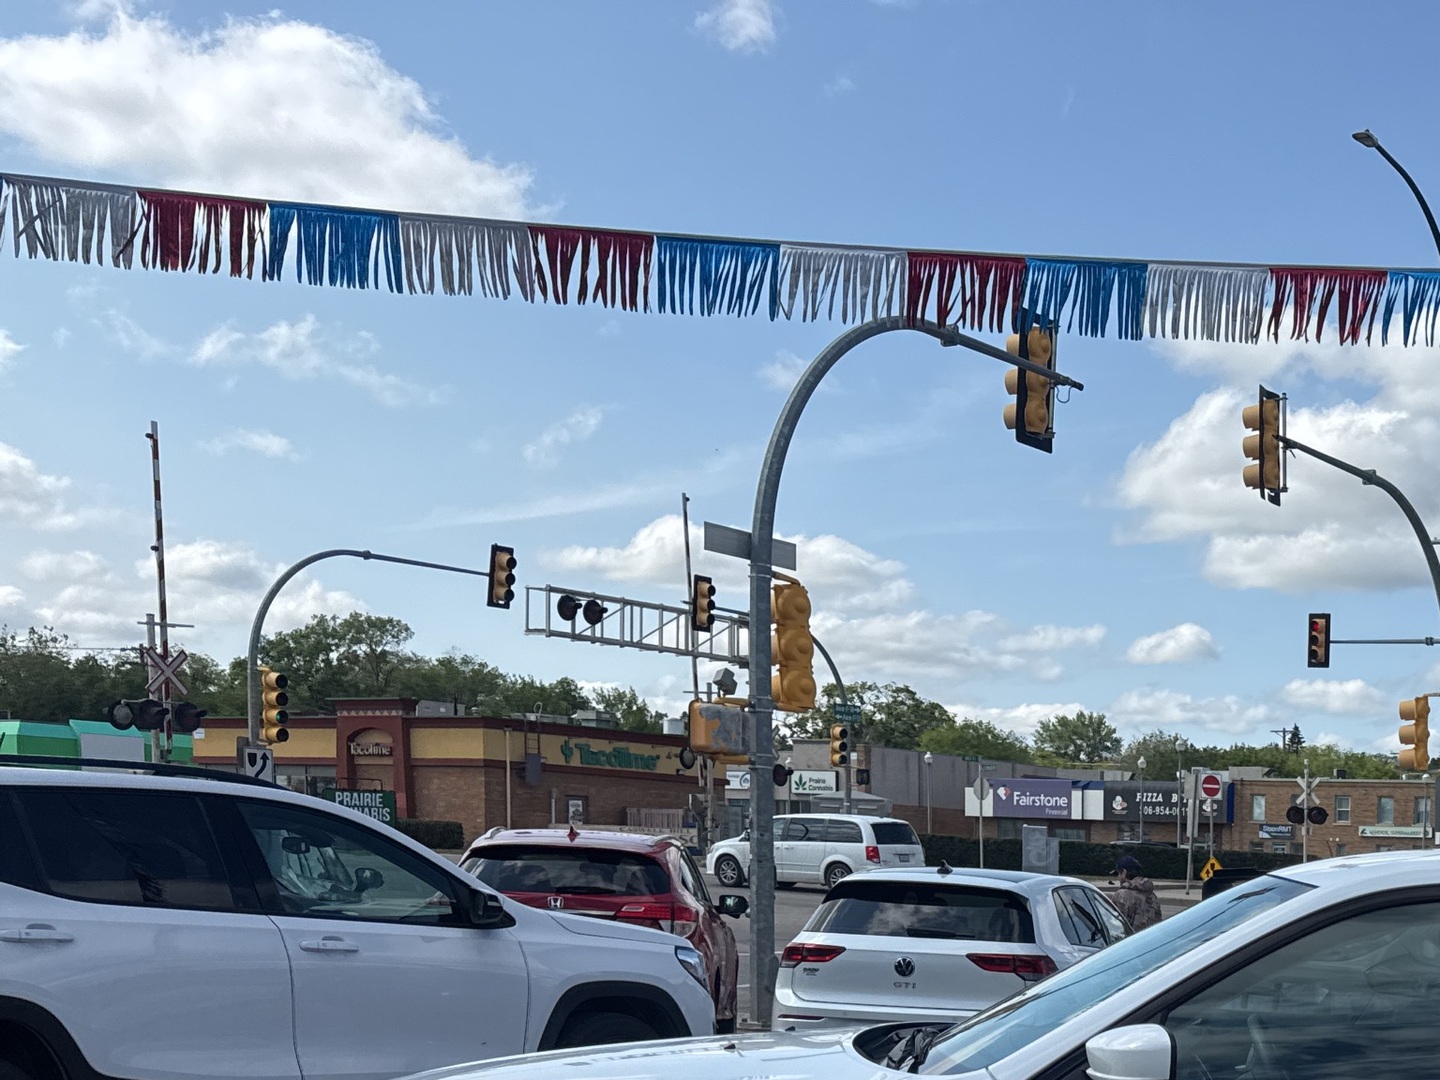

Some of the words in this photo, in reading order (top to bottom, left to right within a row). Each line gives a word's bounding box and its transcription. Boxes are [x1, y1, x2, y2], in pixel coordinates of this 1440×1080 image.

[808, 784, 833, 792] Cannabis
[335, 791, 384, 807] PRAIRIE
[1013, 791, 1068, 807] Fairstone
[1135, 792, 1163, 802] PIZZA
[1045, 808, 1068, 816] Financial
[893, 981, 917, 989] GTI
